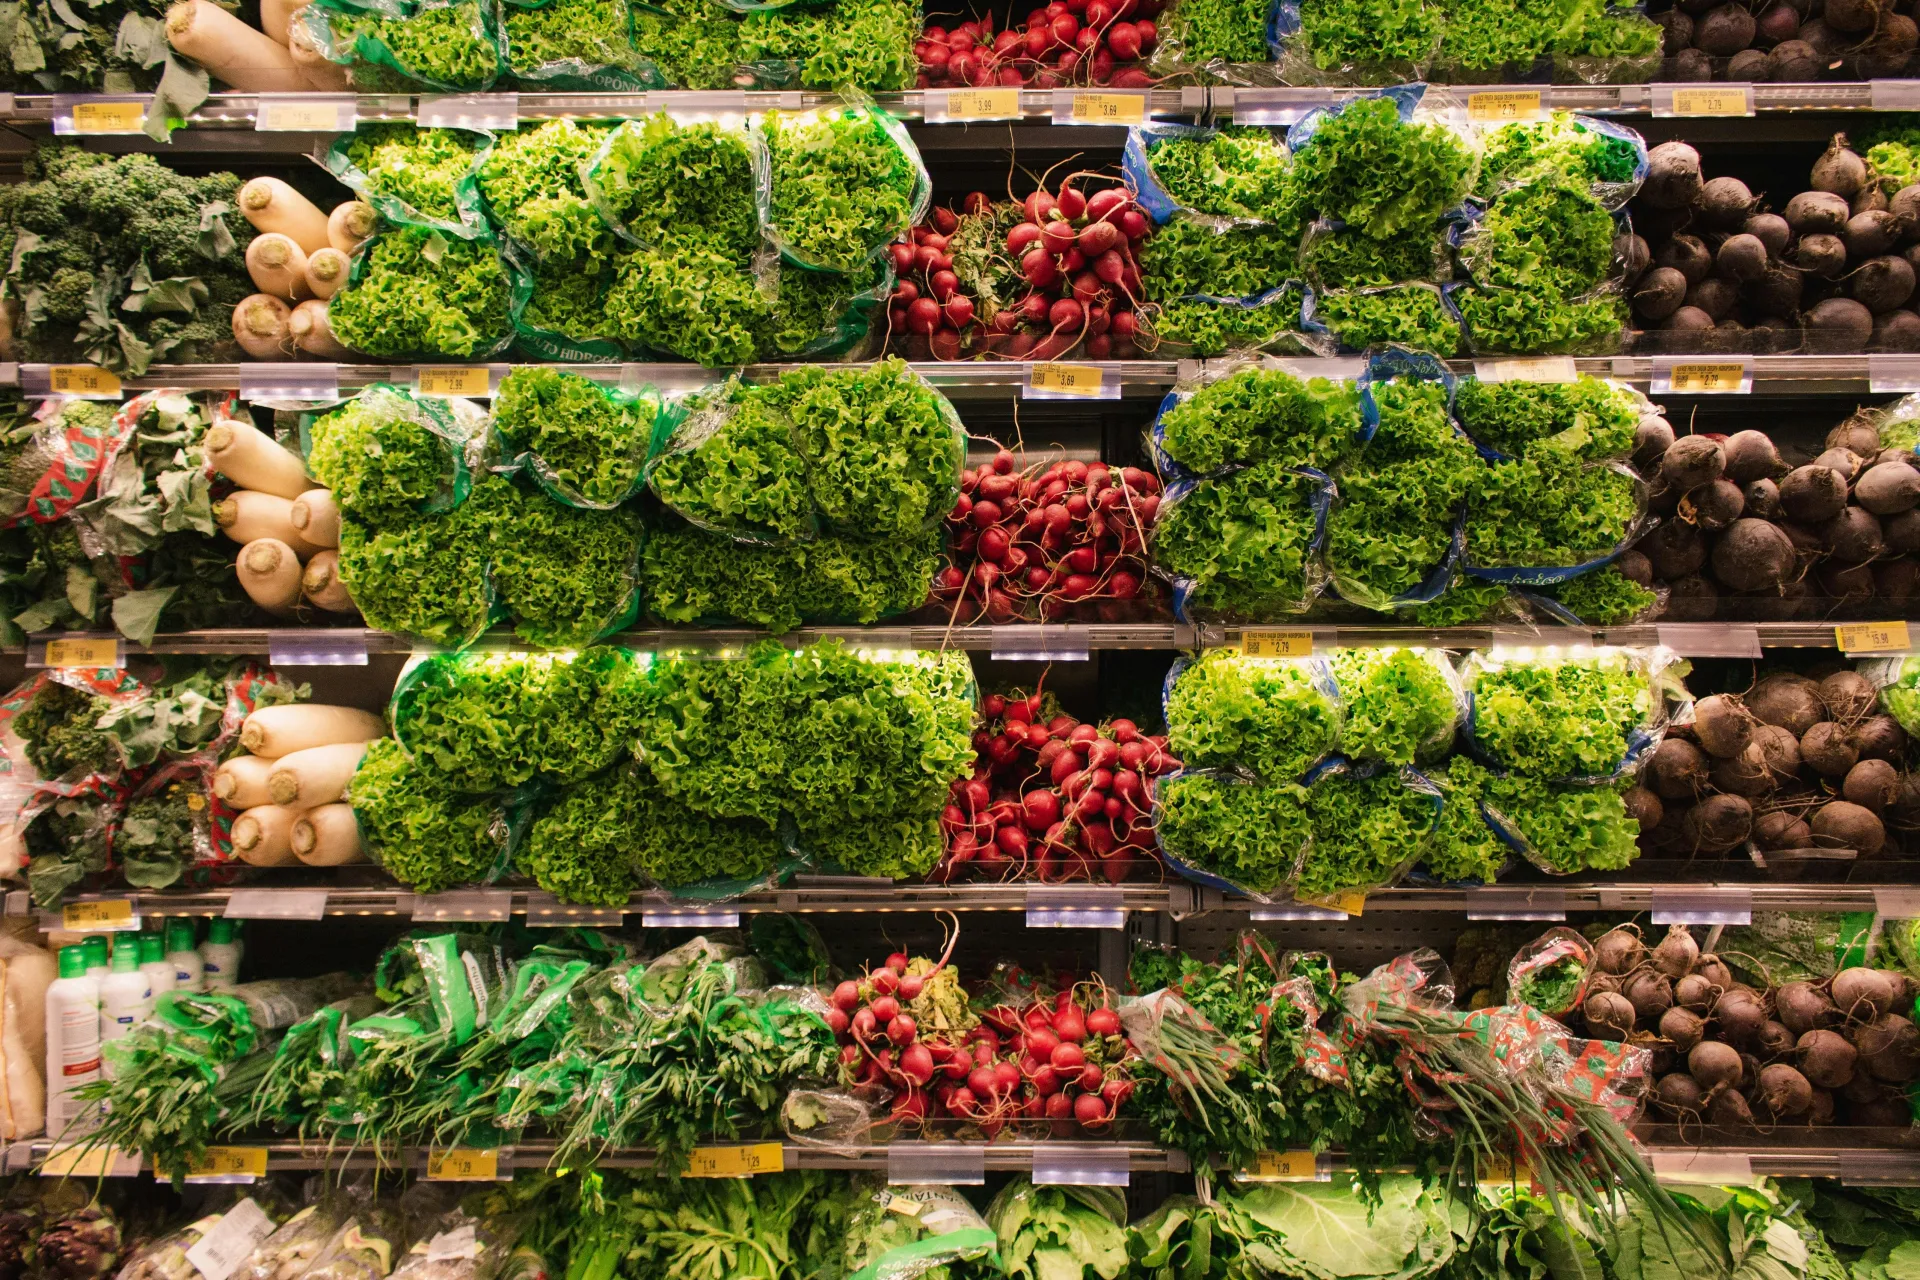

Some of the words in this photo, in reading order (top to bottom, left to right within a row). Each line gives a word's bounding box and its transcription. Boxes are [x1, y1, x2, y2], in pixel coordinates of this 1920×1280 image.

[1103, 104, 1117, 116] 3,69
[1502, 103, 1516, 116] 2,79
[1707, 99, 1721, 111] 2,79
[1060, 374, 1075, 386] 3,69
[1704, 374, 1719, 386] 2,79
[1275, 641, 1289, 654] 2,79
[458, 1161, 471, 1173] 1,29
[747, 1156, 760, 1168] 1,29
[1276, 1163, 1290, 1174] 1,29
